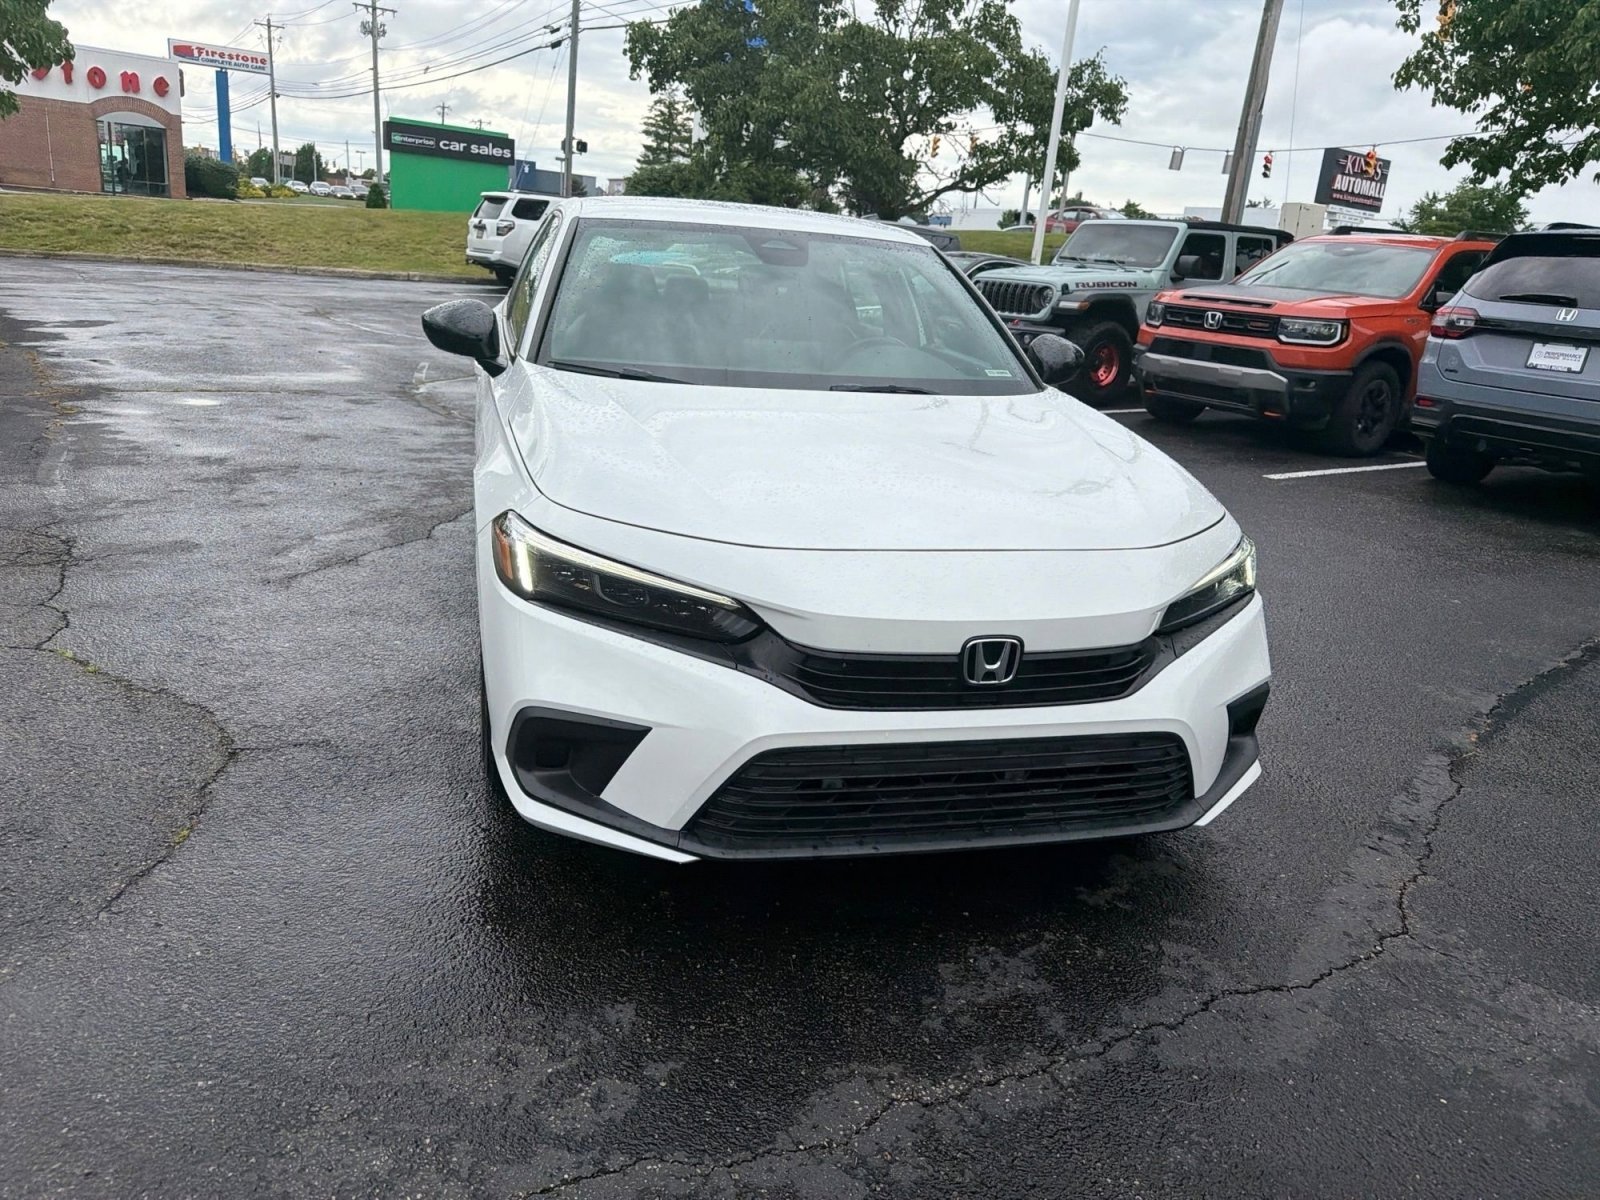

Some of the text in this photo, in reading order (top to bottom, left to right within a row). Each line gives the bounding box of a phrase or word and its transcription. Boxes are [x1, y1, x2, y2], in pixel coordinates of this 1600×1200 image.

[192, 46, 268, 65] Firestone
[201, 57, 232, 67] COMPLETE
[393, 133, 511, 158] enterprise car sales
[1344, 154, 1384, 181] KINS
[1332, 174, 1386, 199] AUTOMALL
[1075, 280, 1138, 289] RUBICON
